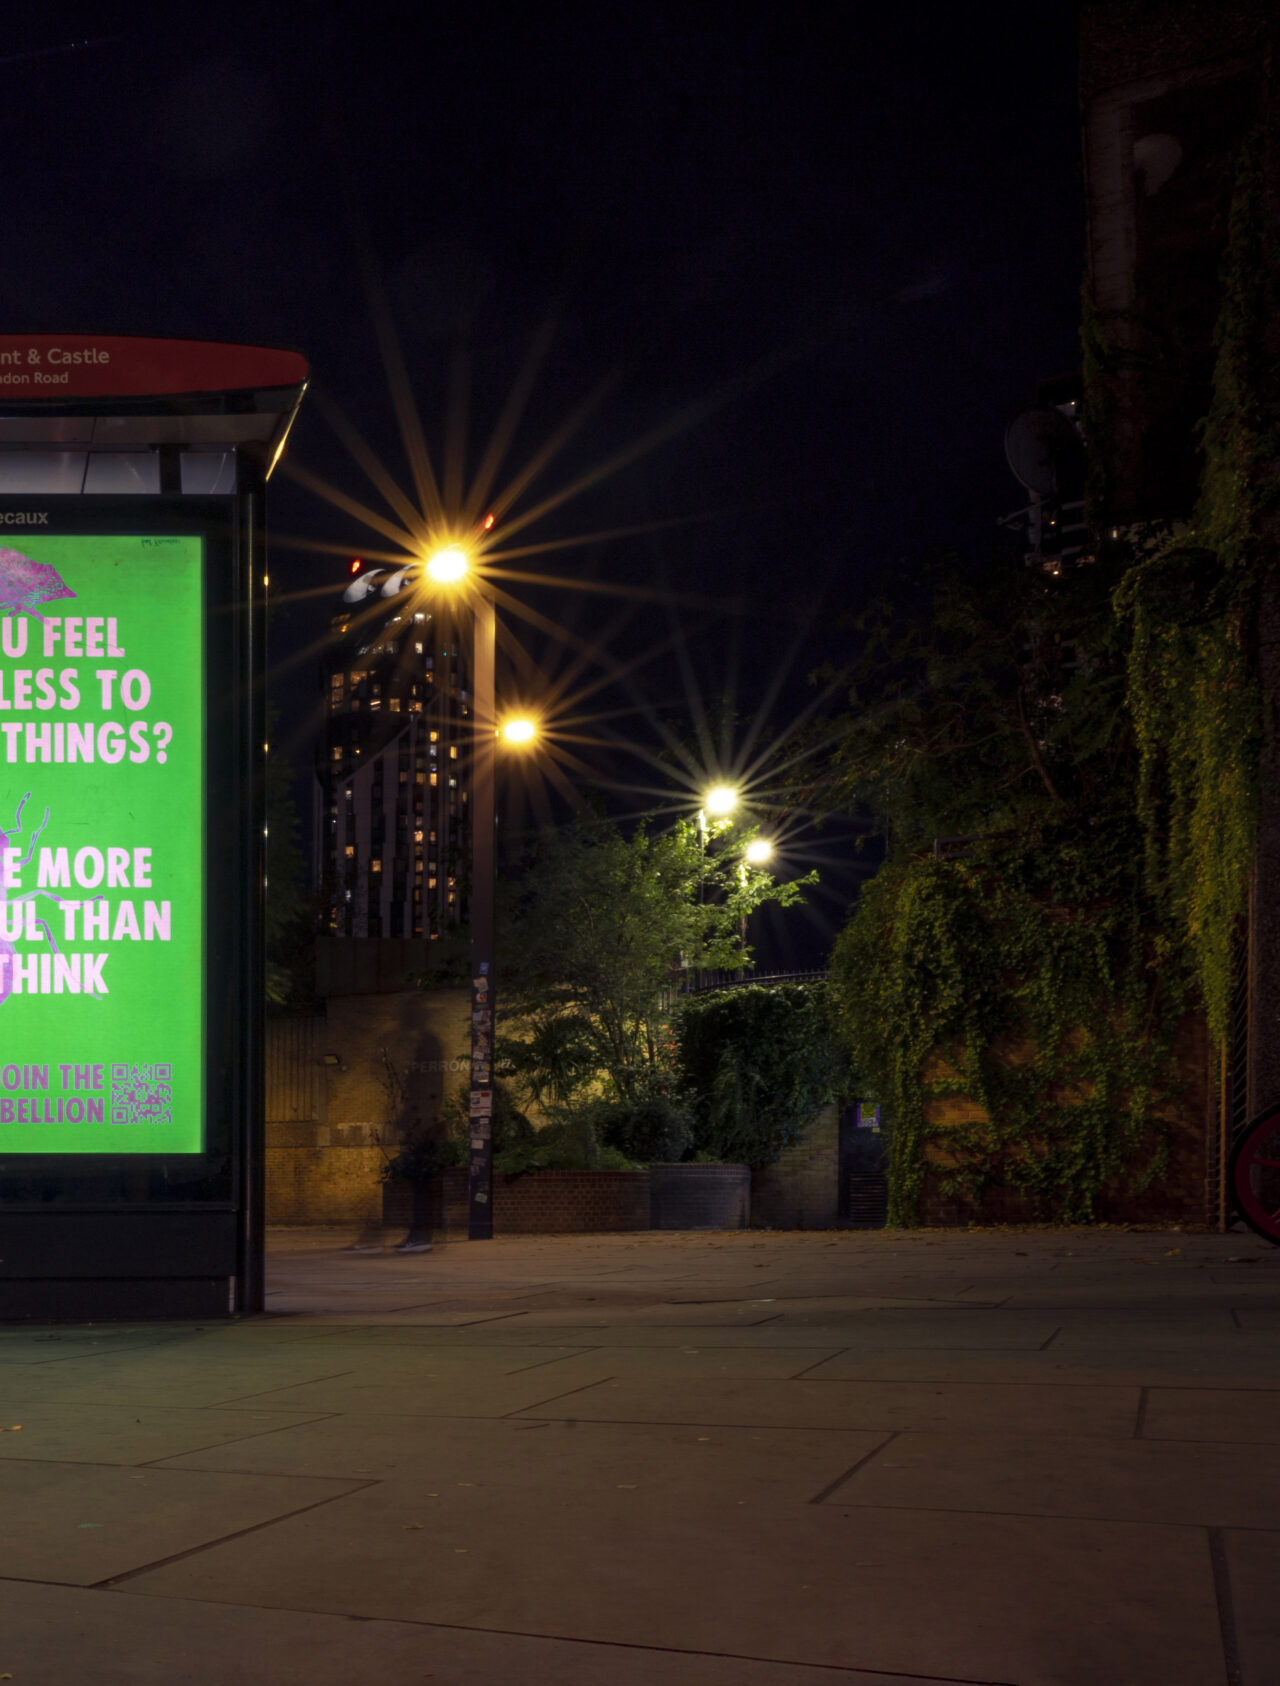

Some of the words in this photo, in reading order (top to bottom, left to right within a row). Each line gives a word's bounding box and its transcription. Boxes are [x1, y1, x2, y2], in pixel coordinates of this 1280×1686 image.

[27, 348, 41, 364] &
[47, 348, 110, 364] Castle
[34, 371, 69, 384] Road
[43, 617, 125, 657] FEEL
[95, 669, 151, 711] TO
[0, 721, 173, 764] THINGS?
[37, 846, 152, 888] MORE
[58, 900, 171, 941] THAN
[58, 1064, 104, 1090] THE
